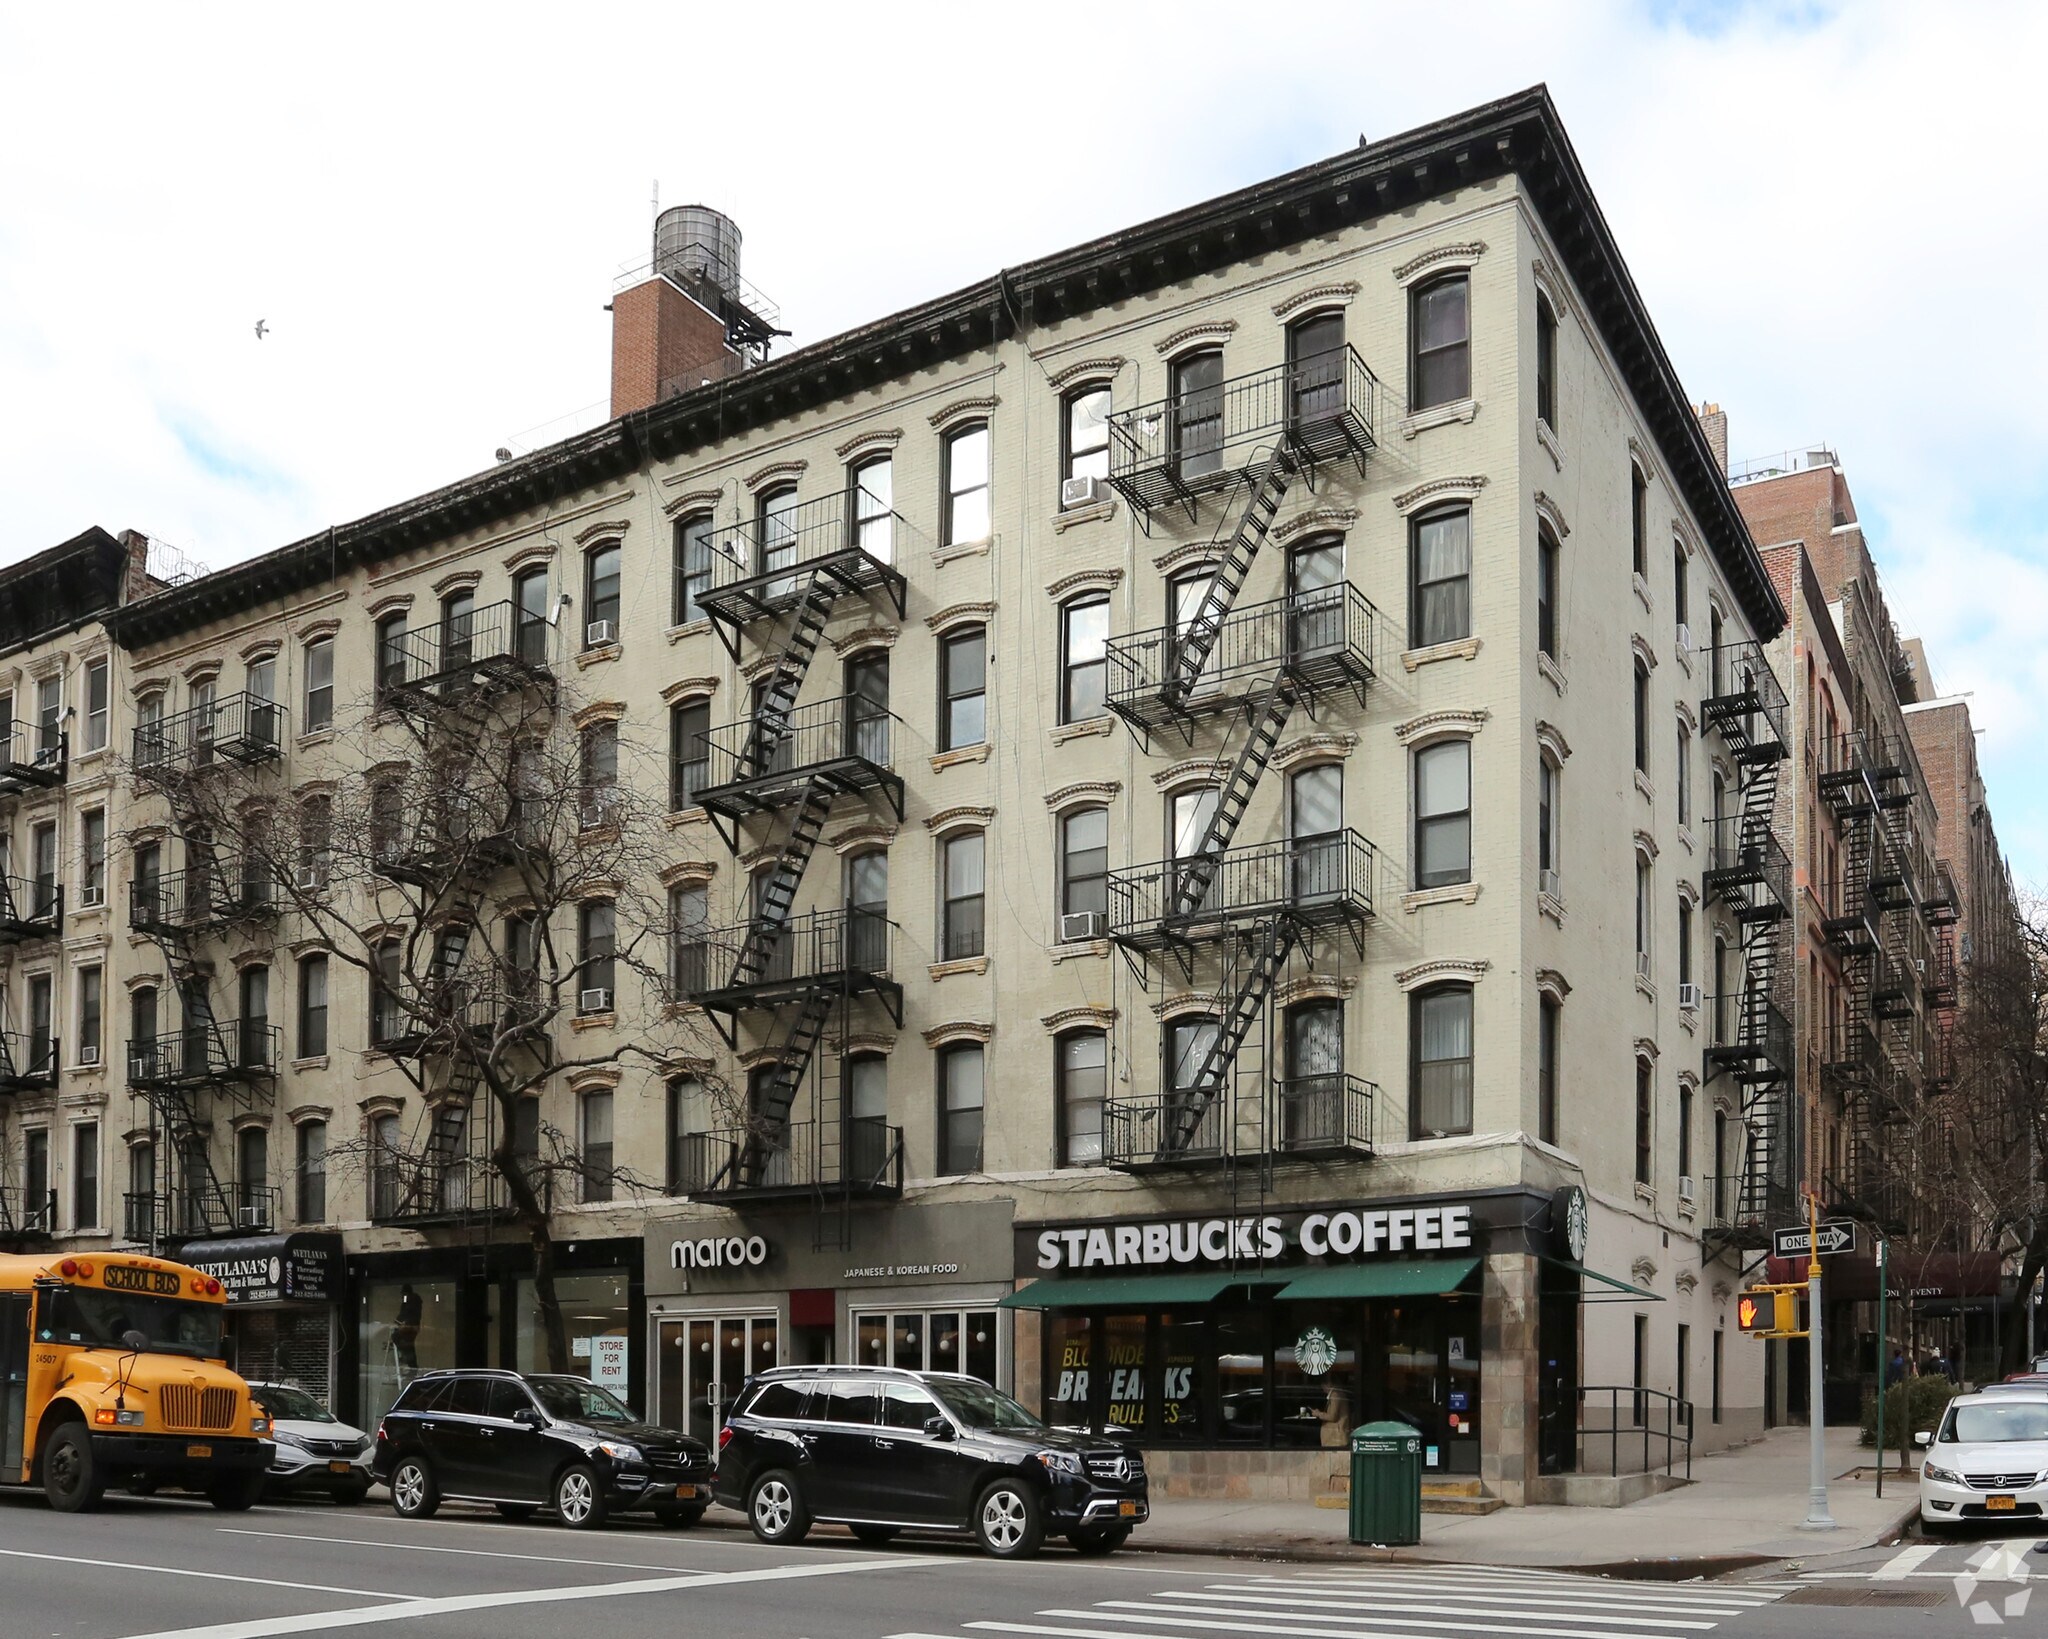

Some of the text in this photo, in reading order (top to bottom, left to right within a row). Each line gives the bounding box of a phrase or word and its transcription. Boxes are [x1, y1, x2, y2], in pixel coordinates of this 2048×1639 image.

[1037, 1205, 1471, 1269] STARBUCKS COFFEE
[1786, 1233, 1841, 1248] ONE WAY
[670, 1235, 766, 1269] maroo
[194, 1258, 267, 1277] SVETLANA'S
[844, 1263, 958, 1278] JAPANESE & KOREAN FOOD
[107, 1265, 178, 1294] SCHOOL BUS
[599, 1341, 624, 1351] STORE
[1450, 1340, 1461, 1353] A
[36, 1354, 57, 1364] 24507
[604, 1354, 619, 1363] FOR
[602, 1366, 621, 1375] RENT
[1109, 1403, 1180, 1424] RULES
